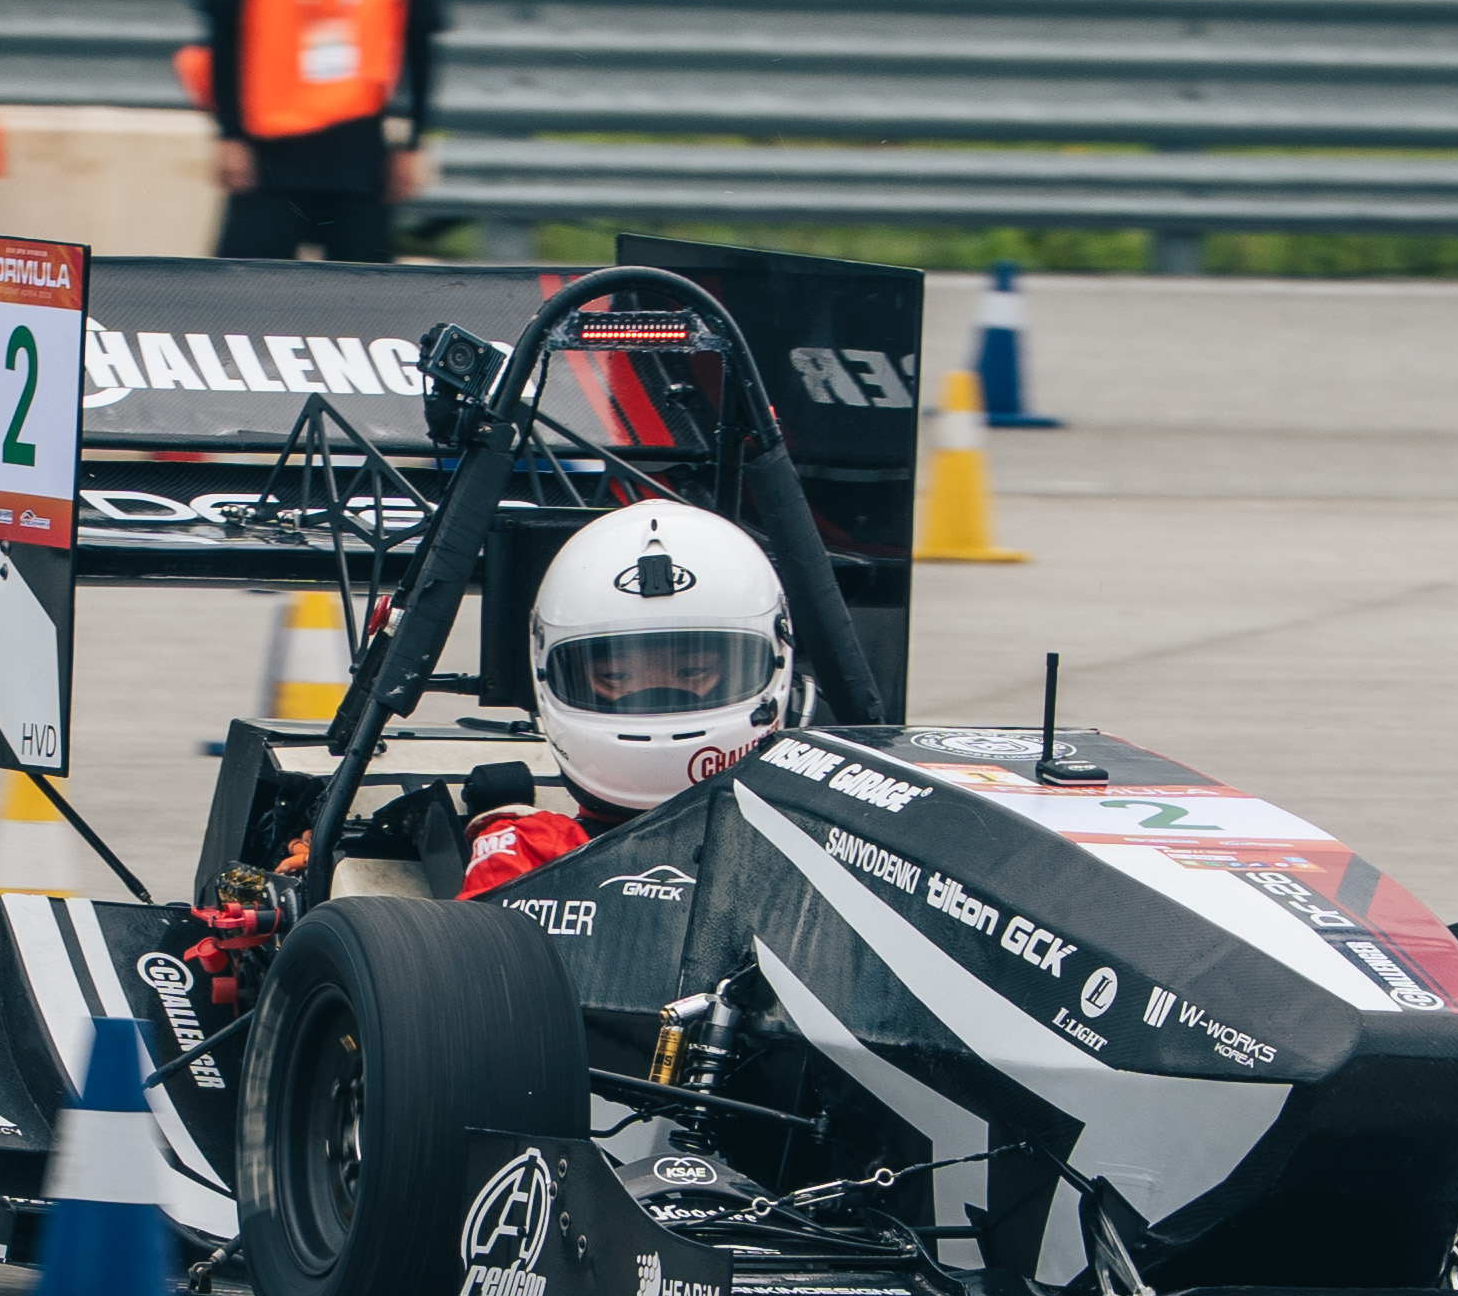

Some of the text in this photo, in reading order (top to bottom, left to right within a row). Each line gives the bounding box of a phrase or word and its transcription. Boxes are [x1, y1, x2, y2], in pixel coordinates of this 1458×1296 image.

[85, 331, 536, 397] HALLENG
[3, 325, 38, 467] 2
[21, 722, 57, 758] HVD
[759, 738, 846, 782] INSANE
[1099, 799, 1225, 831] 2
[473, 832, 517, 857] MP
[926, 871, 1000, 936] tilton
[1000, 915, 1078, 978] GCK
[1178, 1001, 1277, 1063] W-WORKS
[1214, 1042, 1256, 1069] KOREA
[665, 1166, 707, 1179] KSAE
